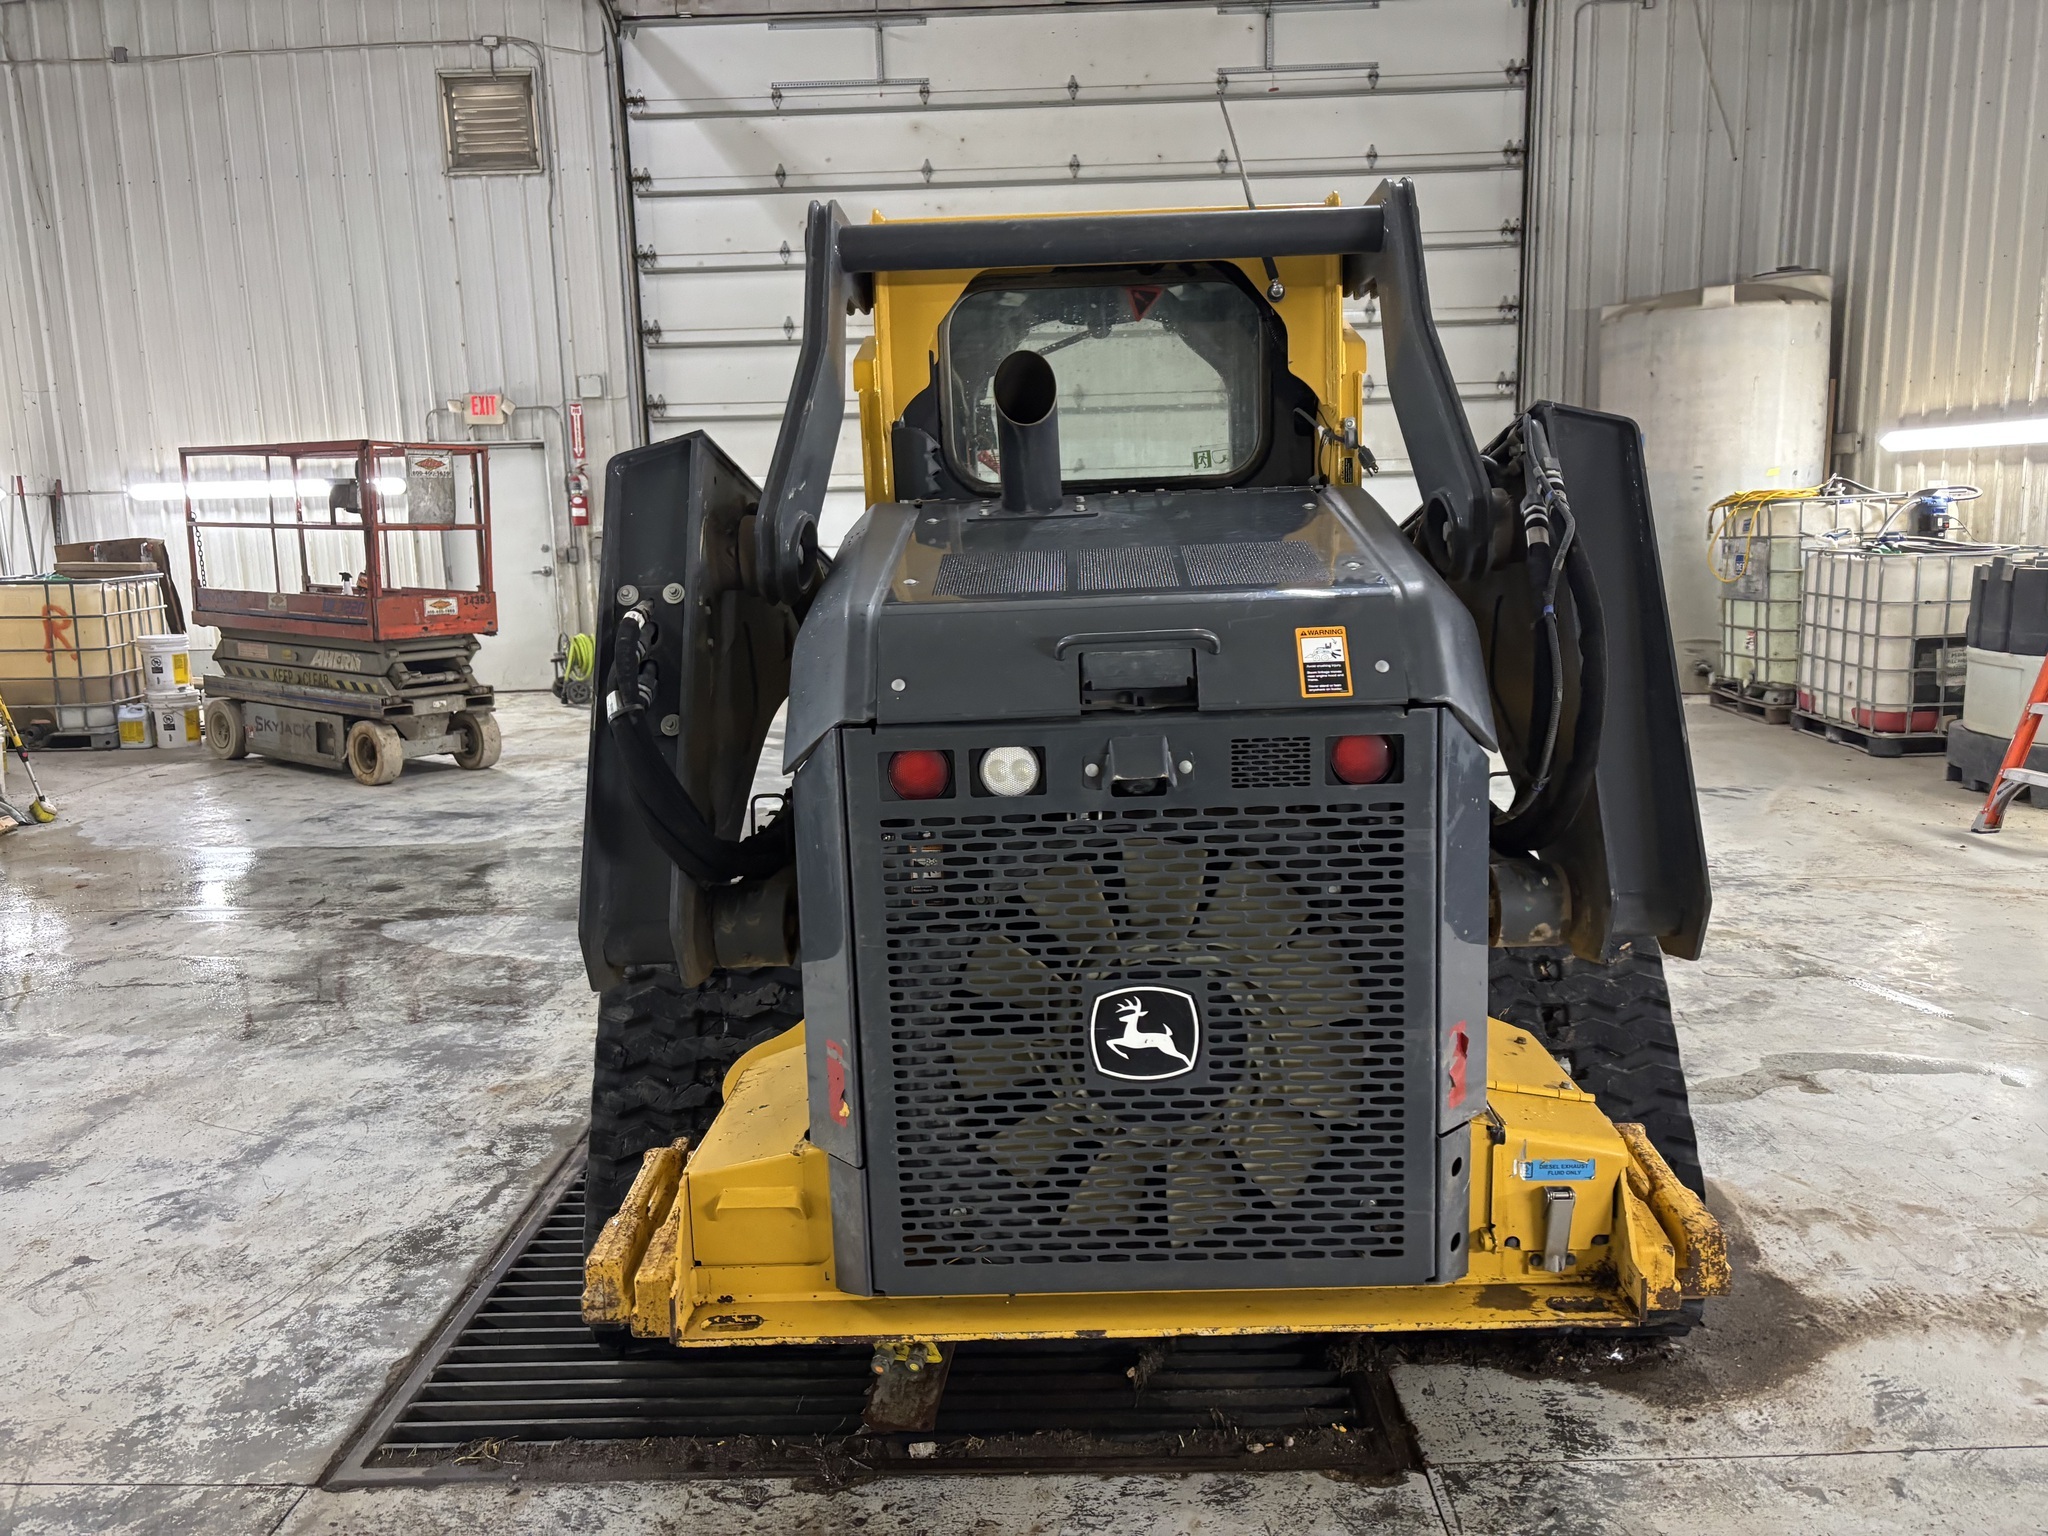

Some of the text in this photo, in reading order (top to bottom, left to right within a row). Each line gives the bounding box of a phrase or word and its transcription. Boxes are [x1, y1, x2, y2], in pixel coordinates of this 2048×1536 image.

[471, 396, 496, 416] EXIT
[42, 604, 77, 662] R
[310, 650, 362, 672] AHERN
[272, 667, 330, 688] KEEP CLEAR
[255, 714, 312, 738] SKYJACK
